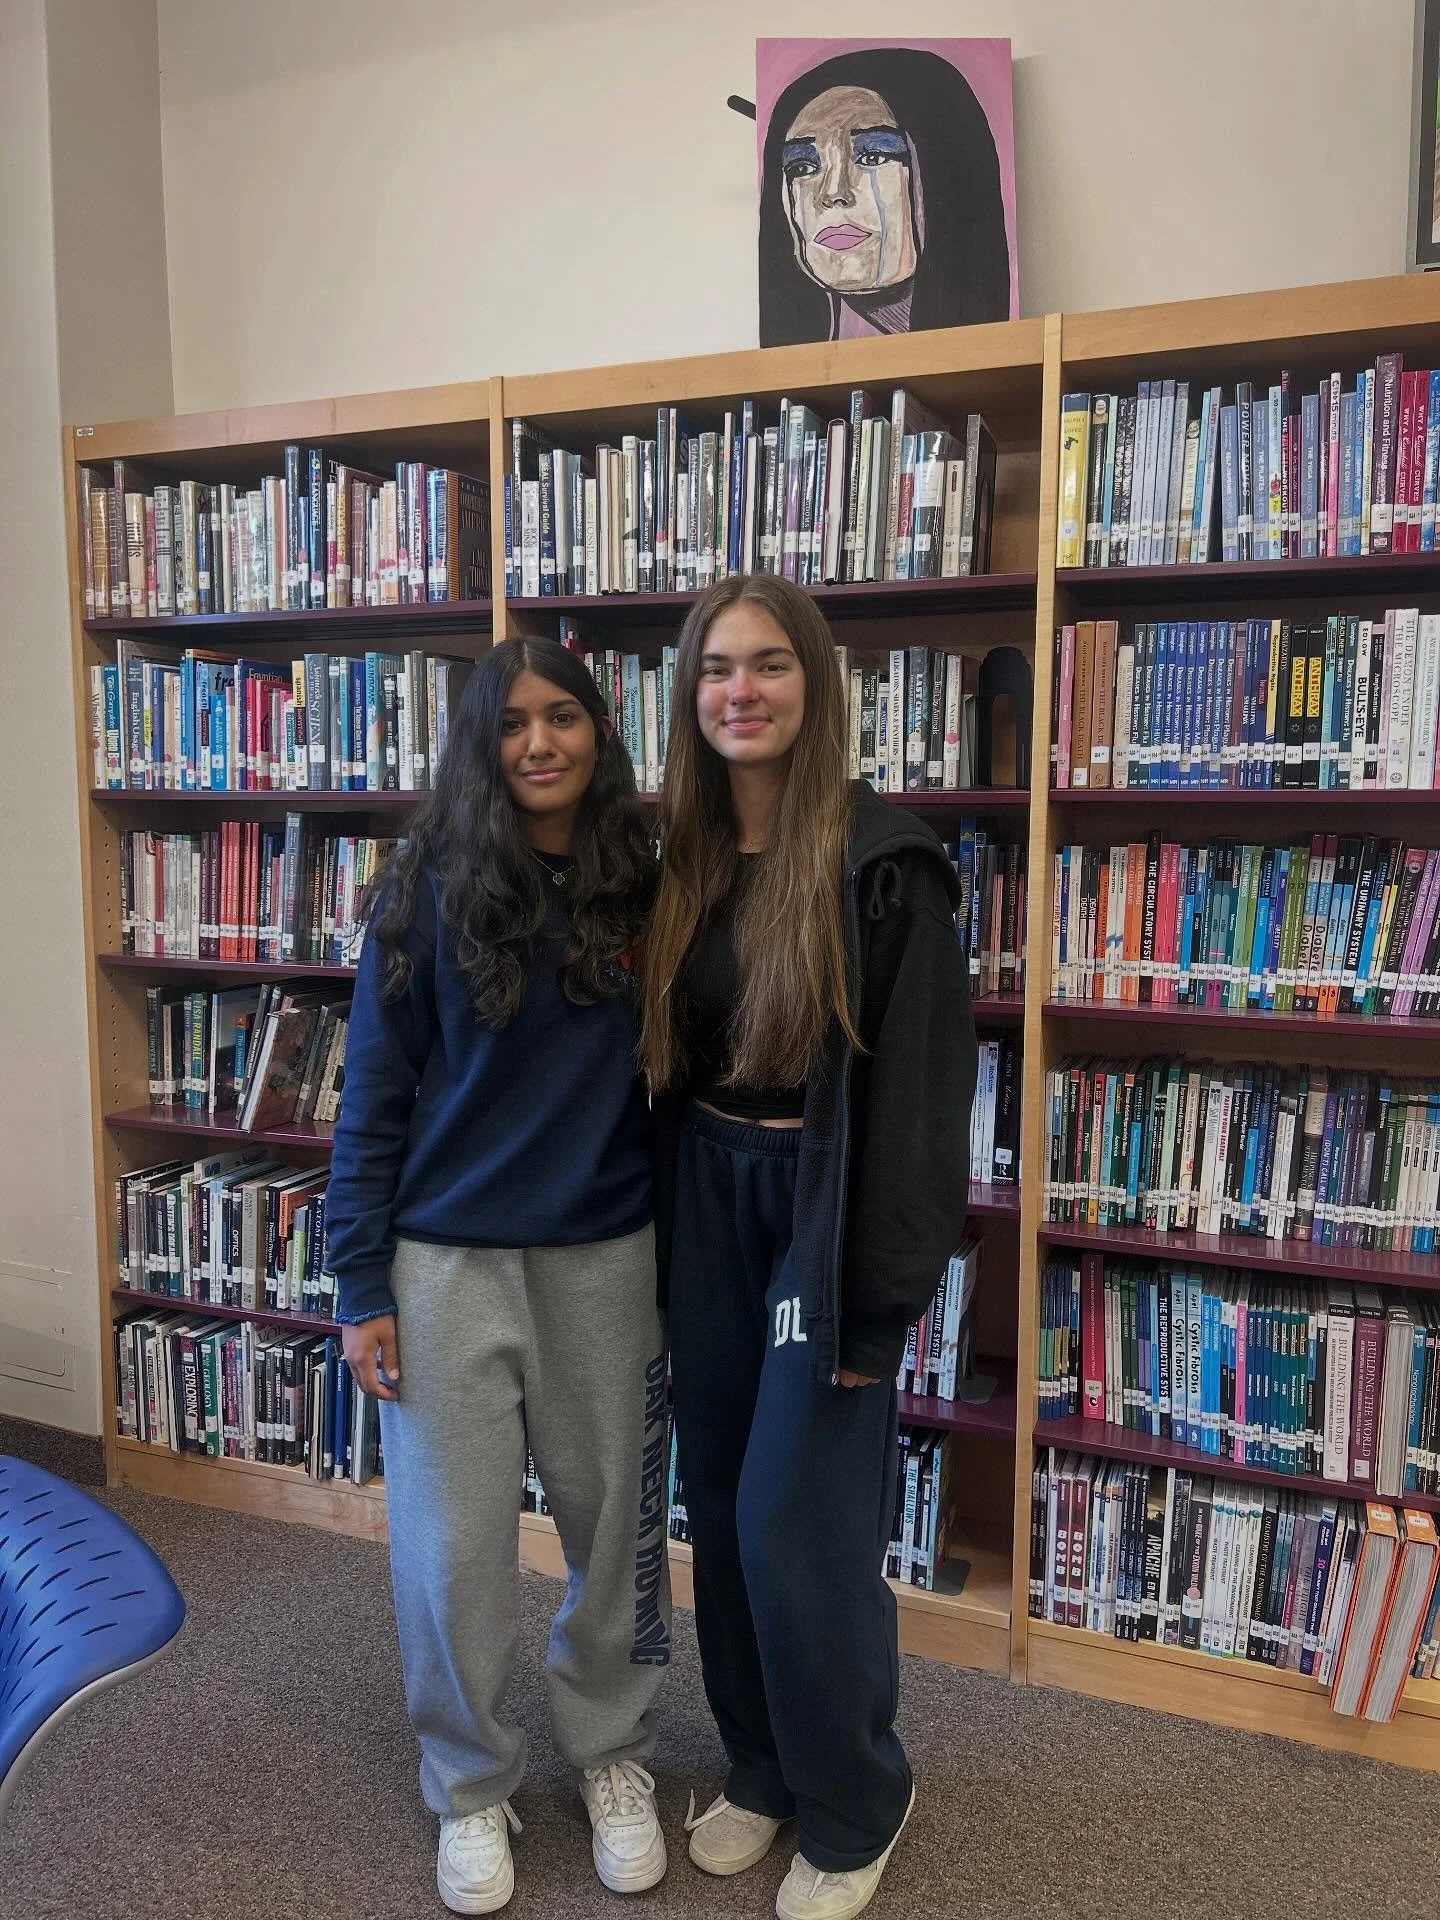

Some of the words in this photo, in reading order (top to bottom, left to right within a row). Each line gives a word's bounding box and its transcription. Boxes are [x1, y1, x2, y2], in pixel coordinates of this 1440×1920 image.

[1383, 379, 1393, 418] Nutrition
[1241, 402, 1250, 448] POWER
[1383, 419, 1392, 436] and
[1381, 438, 1391, 469] Fitness
[541, 482, 550, 511] Survival
[1398, 472, 1406, 503] CURVES
[1413, 470, 1421, 502] CURVES
[542, 513, 550, 533] Guide
[1396, 626, 1404, 647] THE
[1406, 619, 1414, 641] THE
[1403, 645, 1413, 685] DEMON
[295, 677, 304, 706] spanish
[1293, 658, 1304, 716] ANTHRAX
[1309, 658, 1320, 716] ANTHRAX
[131, 692, 141, 725] English
[1401, 689, 1411, 726] UNDER
[1149, 861, 1157, 877] THE
[1361, 870, 1372, 886] THE
[1144, 880, 1156, 938] CIRCULATORY
[1355, 889, 1369, 927] URINARY
[1347, 930, 1362, 965] SYSTEM
[193, 1000, 201, 1019] LISA
[192, 1022, 201, 1061] RANDALL
[1318, 1186, 1326, 1197] ME
[1319, 1168, 1328, 1184] CALL
[315, 1207, 323, 1237] ATOM
[313, 1243, 321, 1265] ISAAC
[1159, 1297, 1167, 1313] THE
[1190, 1294, 1198, 1309] Apel
[1159, 1315, 1168, 1377] REPRODUCTIVE
[1174, 1319, 1185, 1347] Cystic
[1189, 1323, 1200, 1352] Cystic
[1175, 1351, 1185, 1389] Fibrosis
[1190, 1356, 1200, 1394] Fibrosis
[1336, 1339, 1347, 1390] BUILDING
[1364, 1341, 1376, 1392] BUILDING
[184, 1365, 197, 1417] EXPLORING
[203, 1368, 212, 1409] GEOLOGY
[644, 1353, 667, 1434] OAK
[1335, 1394, 1345, 1414] THE
[1363, 1395, 1374, 1416] THE
[1334, 1417, 1345, 1455] WORLD
[1361, 1419, 1373, 1457] WORLD
[638, 1437, 663, 1541] NECK
[908, 1468, 917, 1481] THE
[905, 1485, 916, 1524] SHALLOWS
[1146, 1534, 1162, 1578] APACHE
[630, 1543, 671, 1666] ROWING
